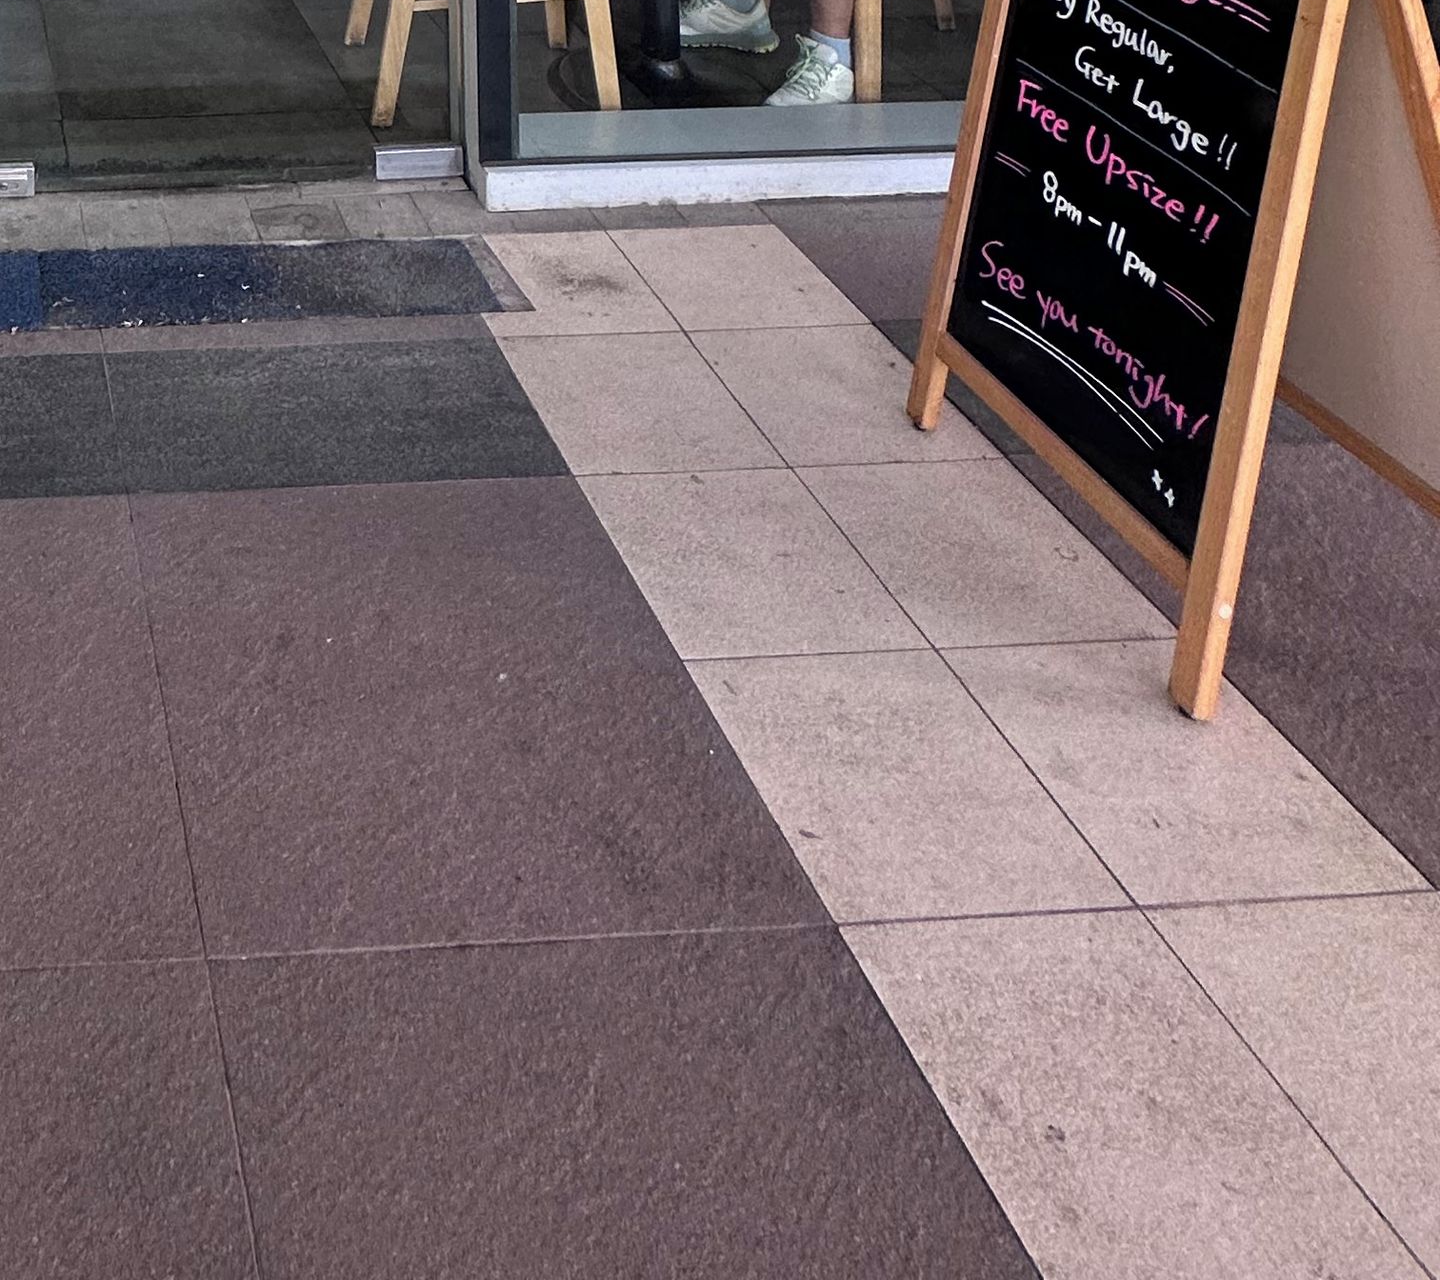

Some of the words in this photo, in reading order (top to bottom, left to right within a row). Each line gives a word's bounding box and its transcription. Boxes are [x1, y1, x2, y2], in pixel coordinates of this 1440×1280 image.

[1075, 46, 1120, 93] Get
[1018, 79, 1069, 143] Free
[979, 241, 1026, 299] See
[1036, 290, 1079, 328] you
[1088, 326, 1209, 439] tonight!
